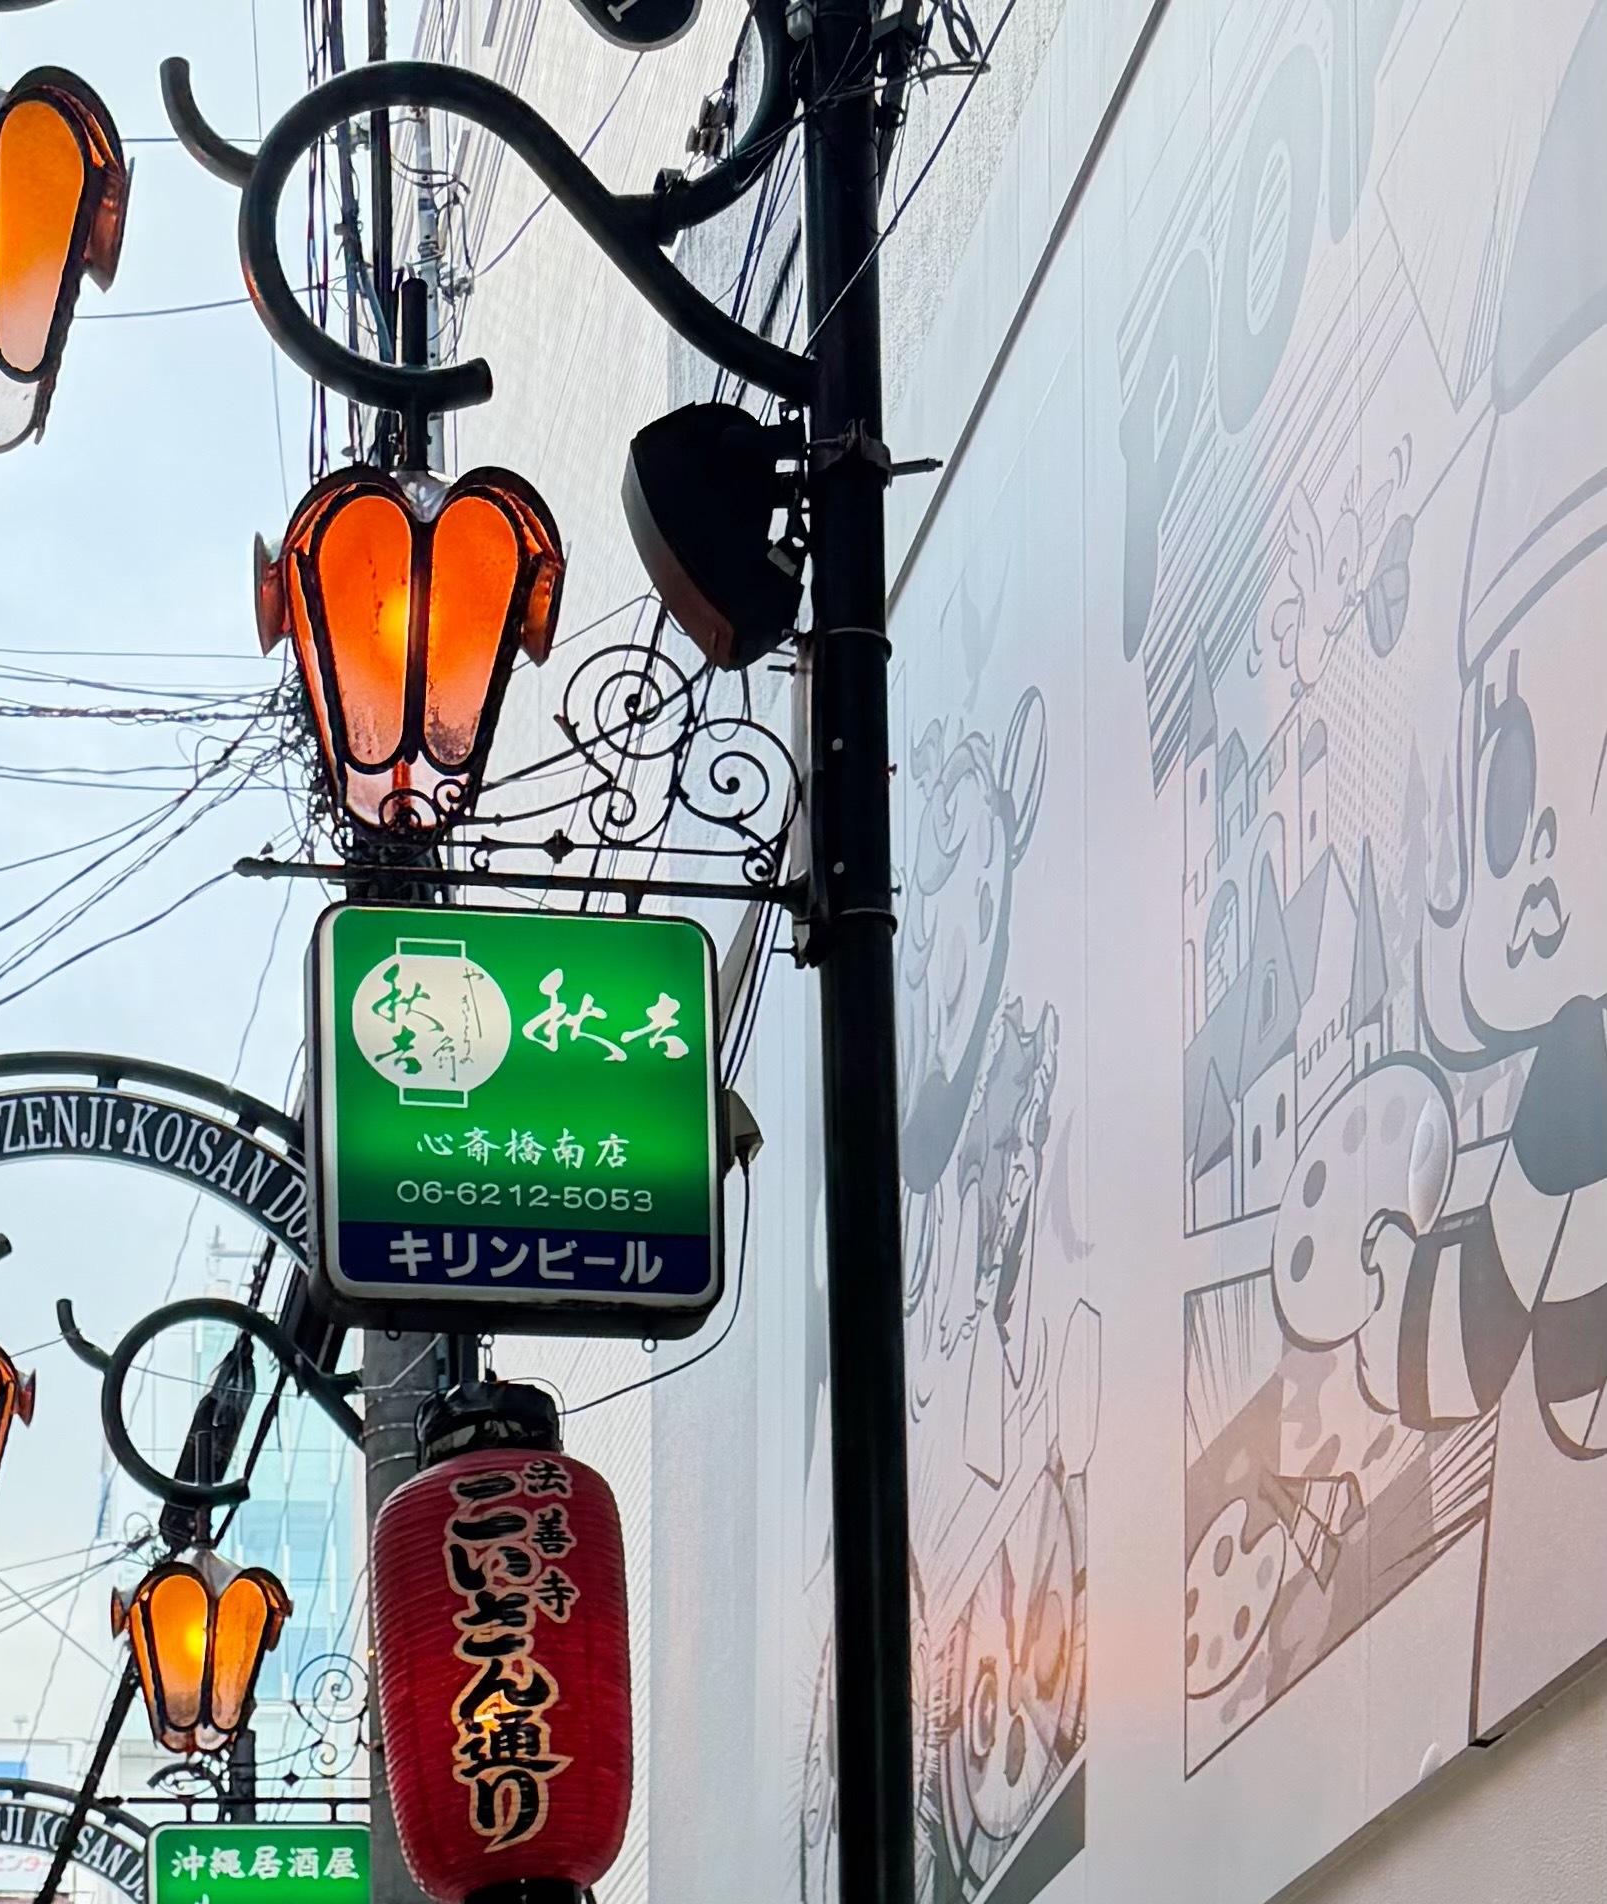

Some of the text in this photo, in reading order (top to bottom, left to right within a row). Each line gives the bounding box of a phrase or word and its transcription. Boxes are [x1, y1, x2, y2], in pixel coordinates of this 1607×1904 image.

[373, 963, 445, 1075] 秋吉
[522, 968, 690, 1062] 秋吉
[416, 1126, 631, 1169] 心斎橋南店
[396, 1180, 654, 1213] 06-6212-5053
[388, 1231, 663, 1284] キリンビール
[525, 1460, 578, 1620] 法善寺
[30, 1807, 132, 1878] KOSAN
[170, 1845, 360, 1881] 沖縄居酒屋
